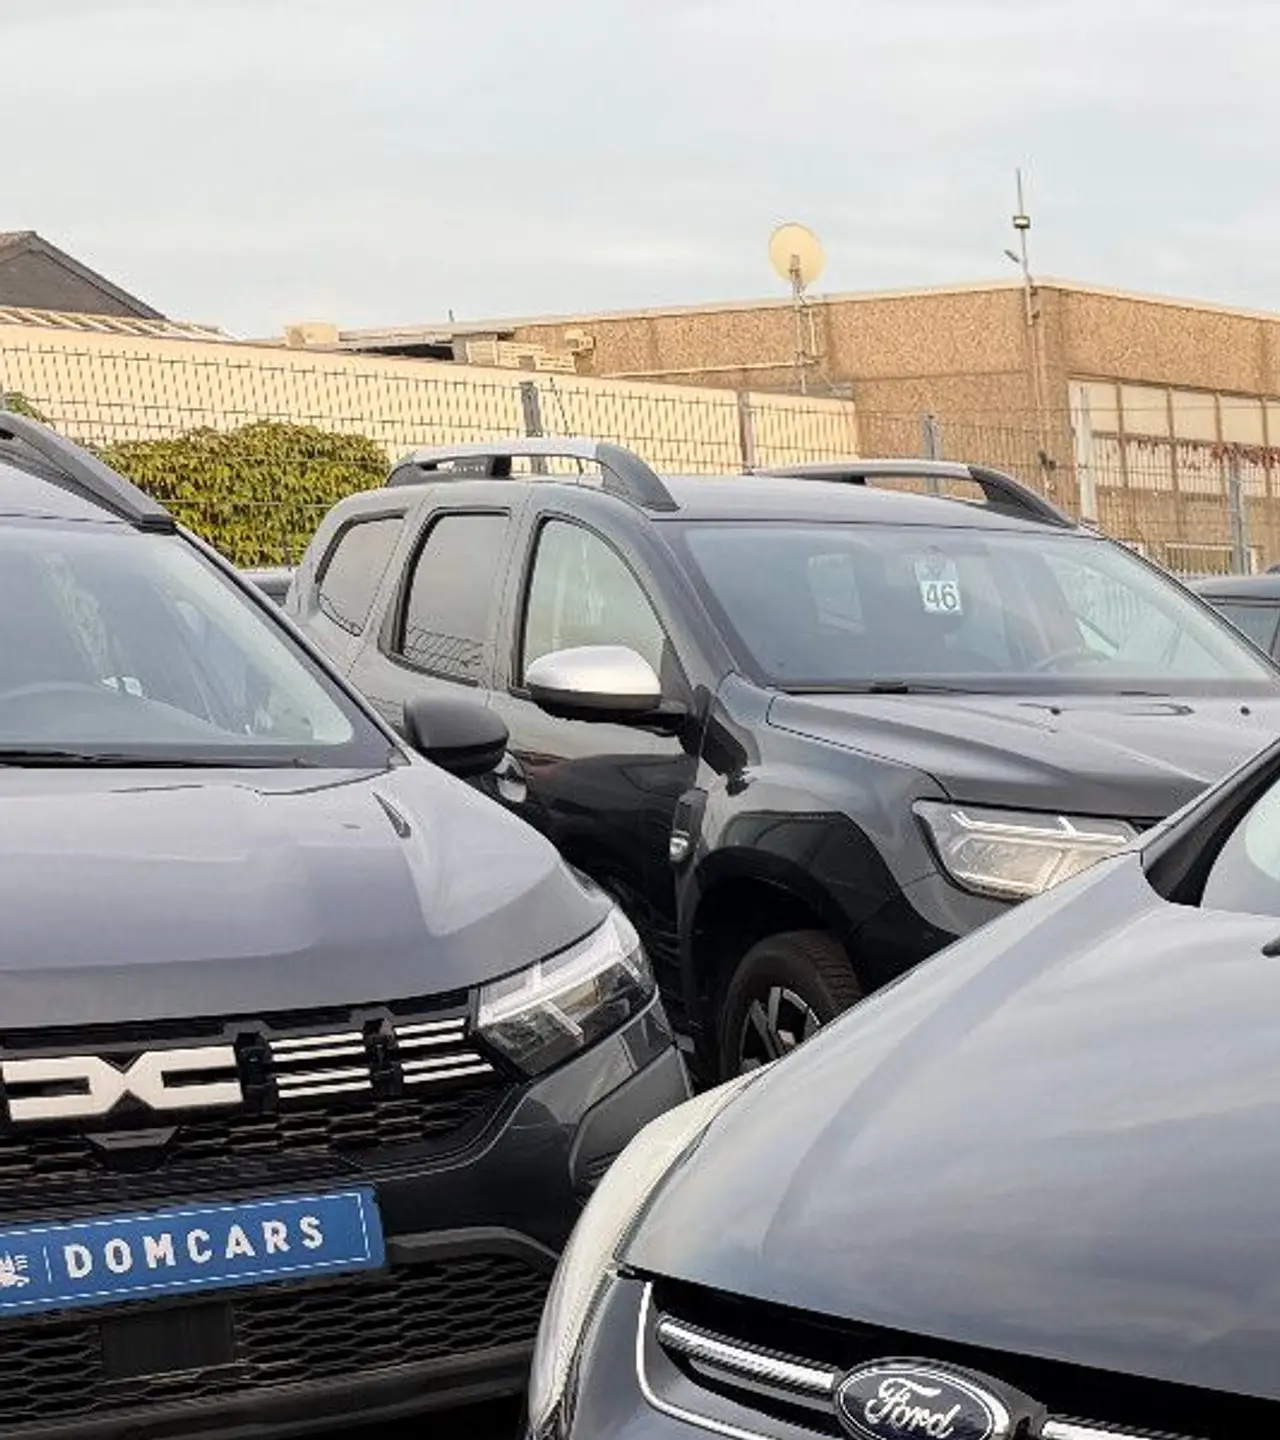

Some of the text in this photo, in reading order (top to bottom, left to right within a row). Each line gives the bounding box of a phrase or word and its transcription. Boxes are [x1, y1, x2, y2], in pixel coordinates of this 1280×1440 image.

[926, 583, 958, 610] 46
[63, 1216, 324, 1279] DOMCARS
[864, 1377, 962, 1440] Ford
